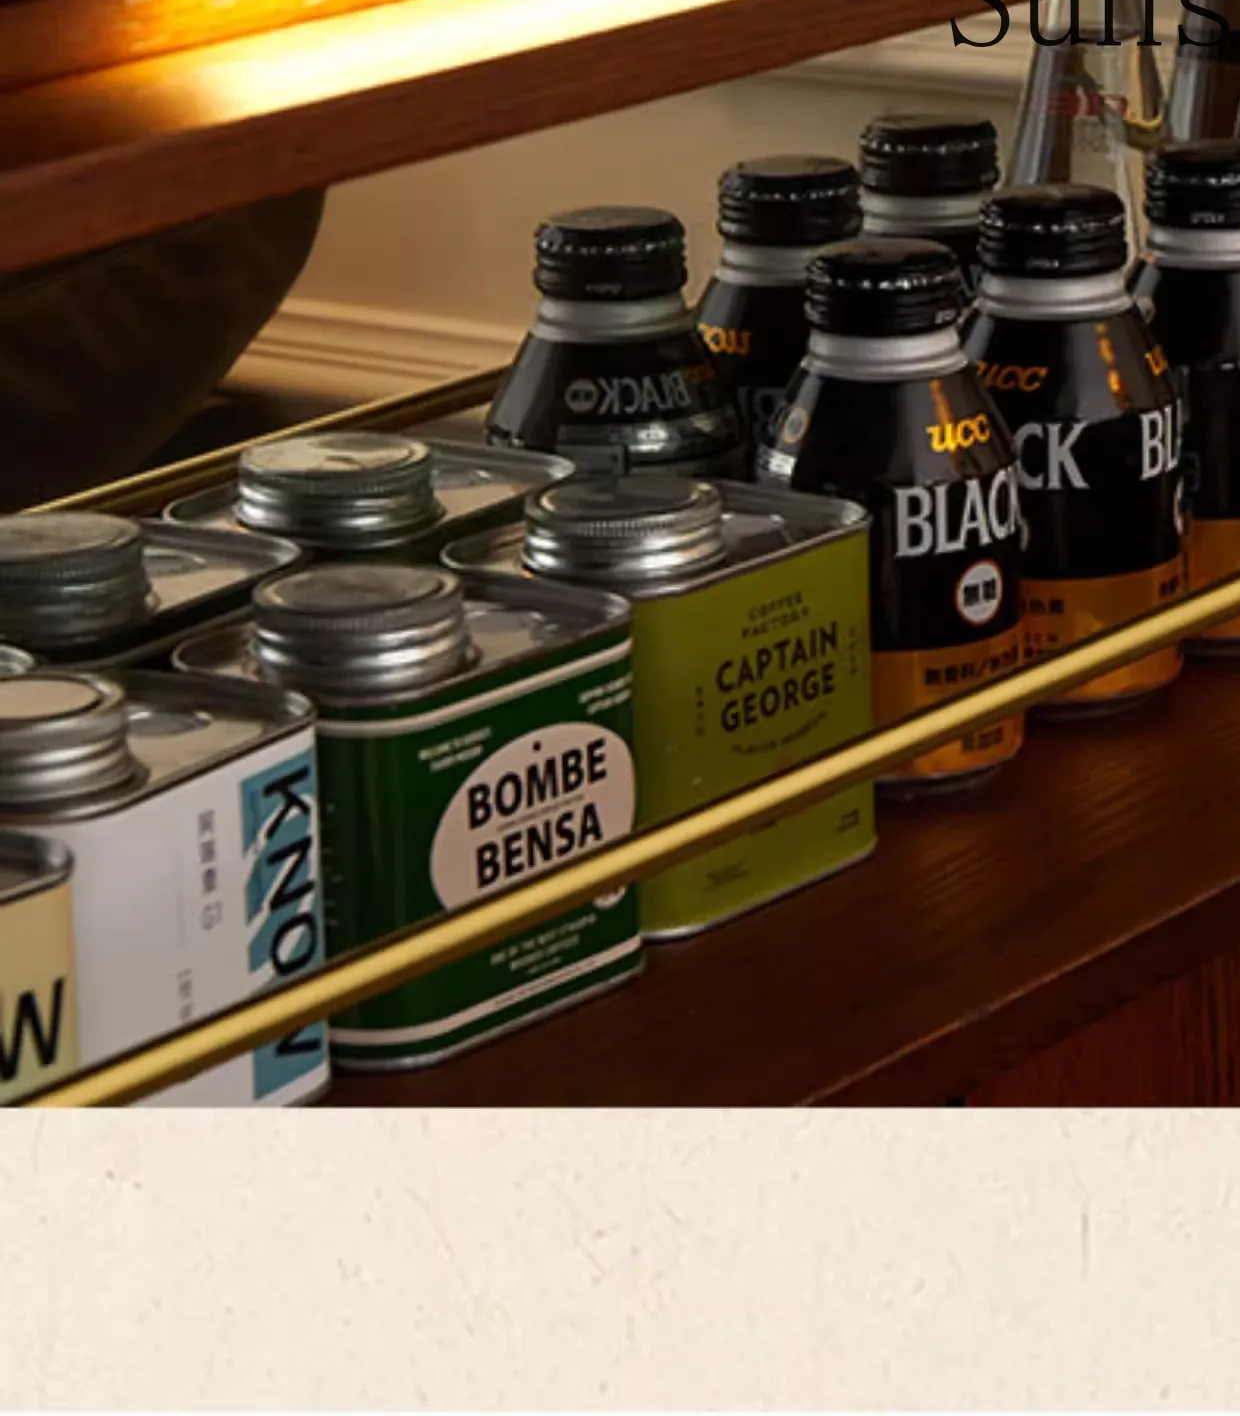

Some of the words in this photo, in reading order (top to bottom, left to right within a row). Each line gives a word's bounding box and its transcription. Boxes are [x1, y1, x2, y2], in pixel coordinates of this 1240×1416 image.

[926, 413, 991, 452] ucc
[715, 620, 838, 693] CAPTAIN
[720, 662, 836, 732] GEORGE
[468, 738, 607, 830] BOMBE
[477, 803, 604, 889] BENSA
